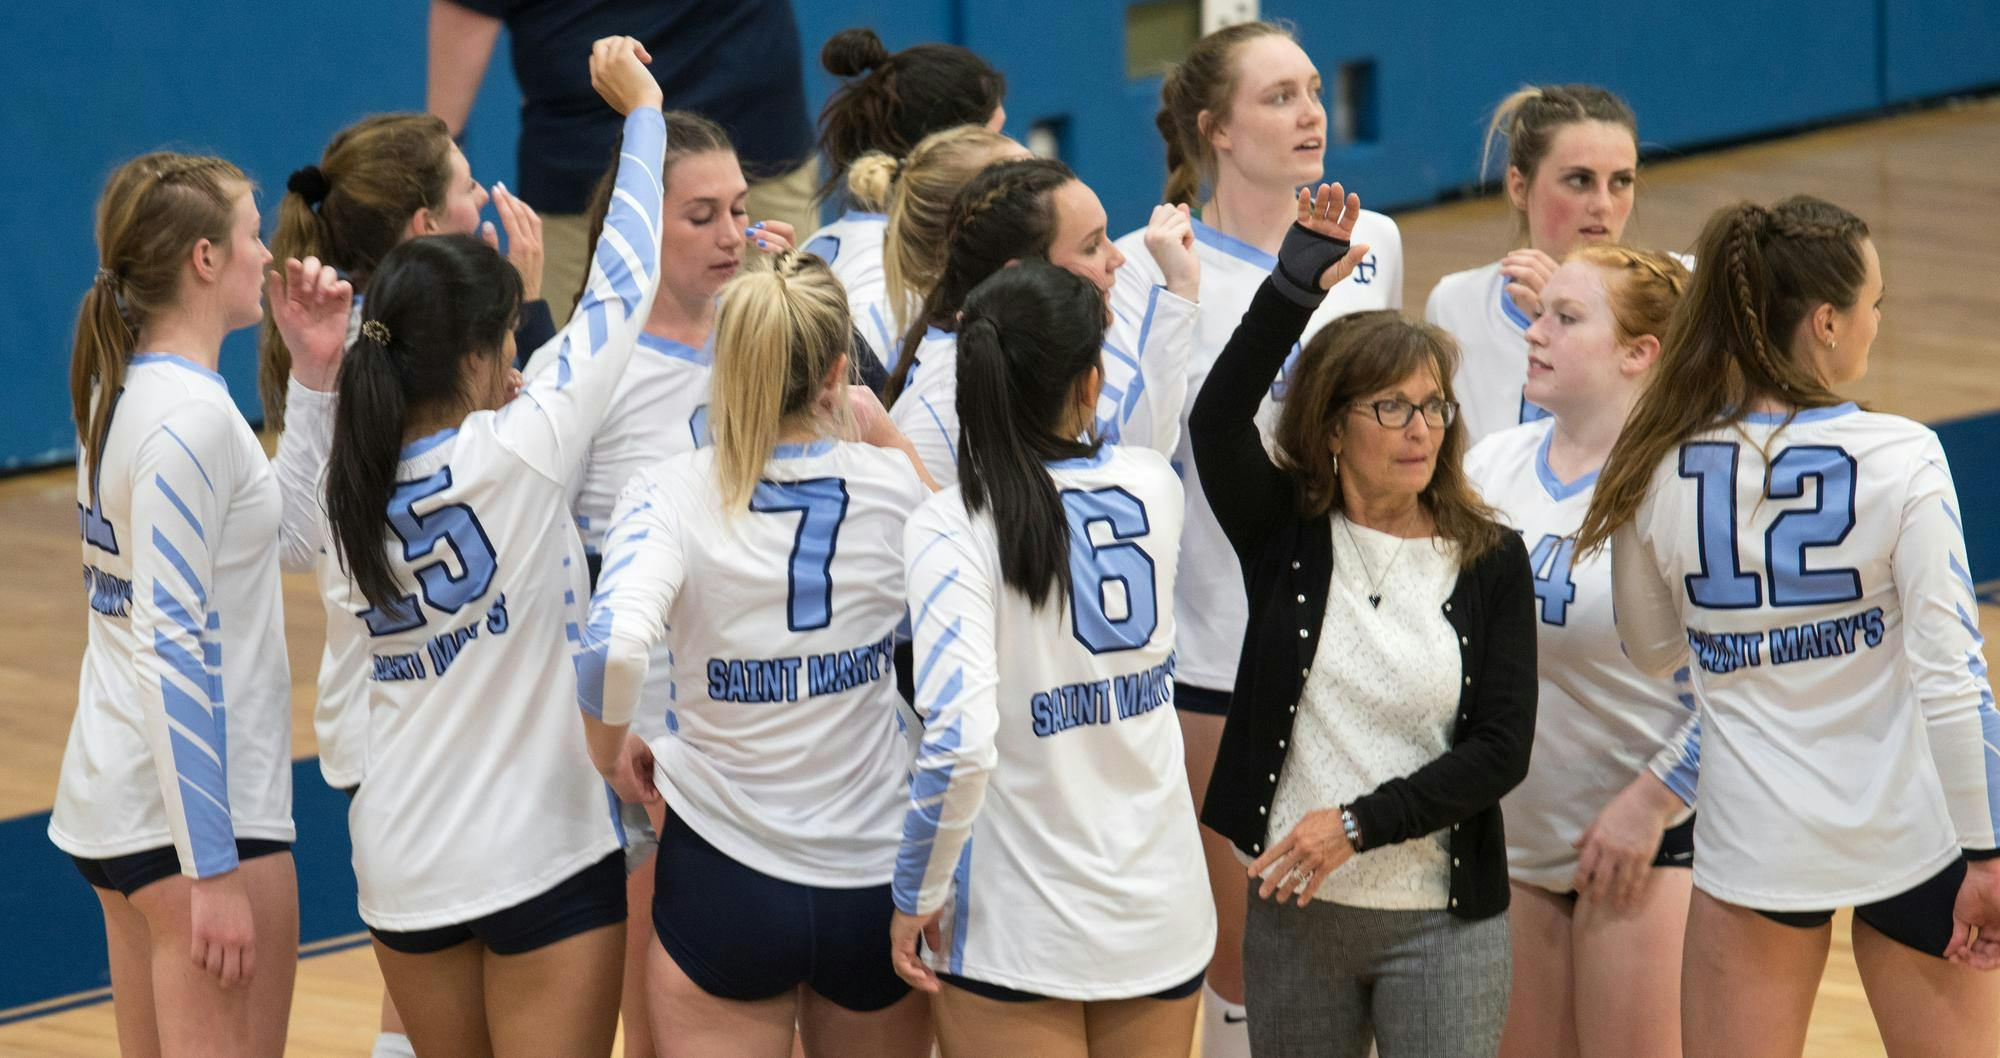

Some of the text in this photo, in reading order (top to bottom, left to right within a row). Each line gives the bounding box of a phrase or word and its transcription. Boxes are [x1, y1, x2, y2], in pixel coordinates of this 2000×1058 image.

[77, 386, 124, 556] 1
[1678, 441, 1864, 610] 12
[749, 477, 849, 631] 7
[1060, 485, 1158, 655] 6
[1517, 530, 1576, 627] 4
[706, 657, 802, 703] SAINT
[1768, 606, 1885, 666] MARY'S
[1031, 679, 1111, 738] SAINT
